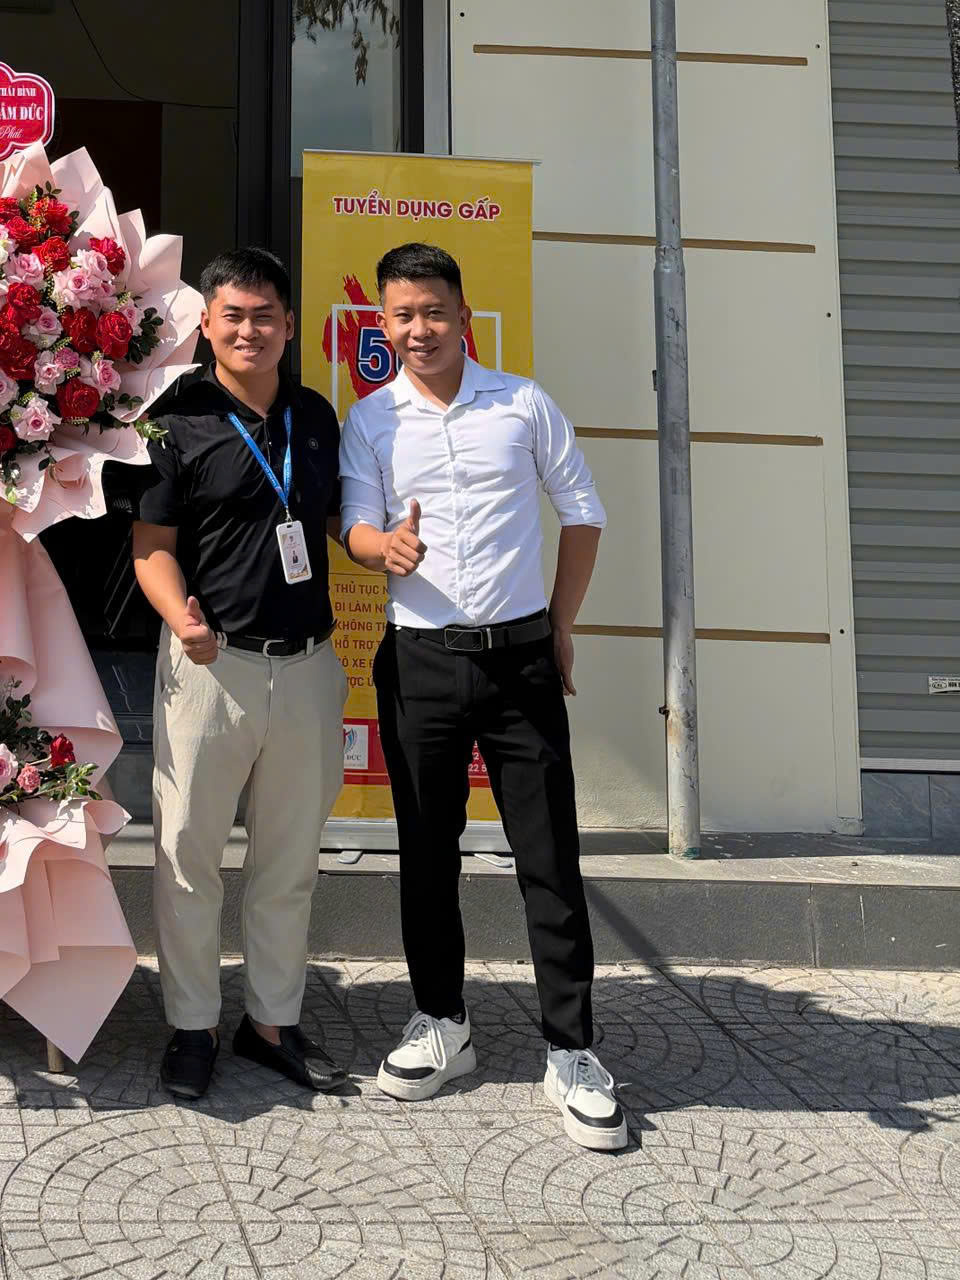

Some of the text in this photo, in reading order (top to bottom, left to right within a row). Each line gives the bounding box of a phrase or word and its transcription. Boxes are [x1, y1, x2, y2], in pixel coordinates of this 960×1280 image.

[333, 188, 501, 222] TUYỂN DỤNG GẤP
[359, 585, 379, 597] TỤC
[352, 658, 366, 669] XE
